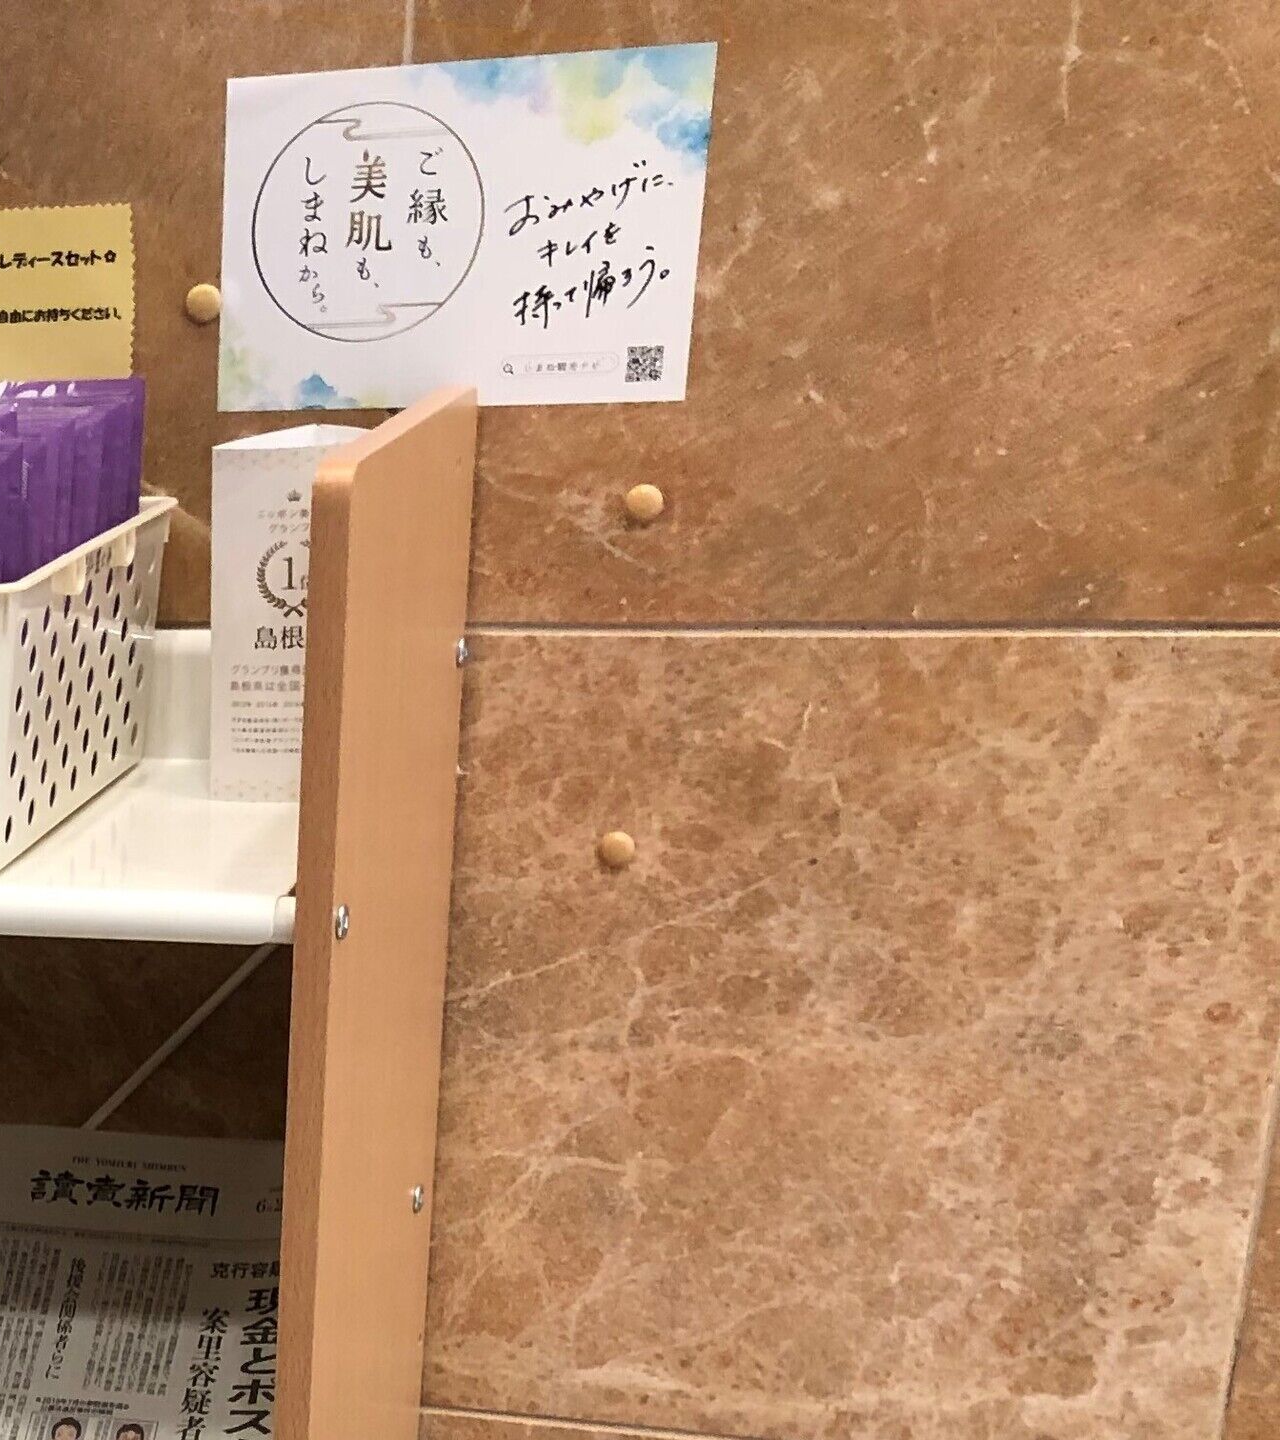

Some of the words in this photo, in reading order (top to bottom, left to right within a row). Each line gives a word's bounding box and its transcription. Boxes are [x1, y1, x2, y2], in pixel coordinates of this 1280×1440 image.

[298, 156, 328, 313] しまねから。
[345, 150, 392, 288] 美肌も、
[407, 148, 448, 269] ご縁も、
[538, 222, 622, 266] キレイを
[512, 246, 670, 329] 持って帰ろう。
